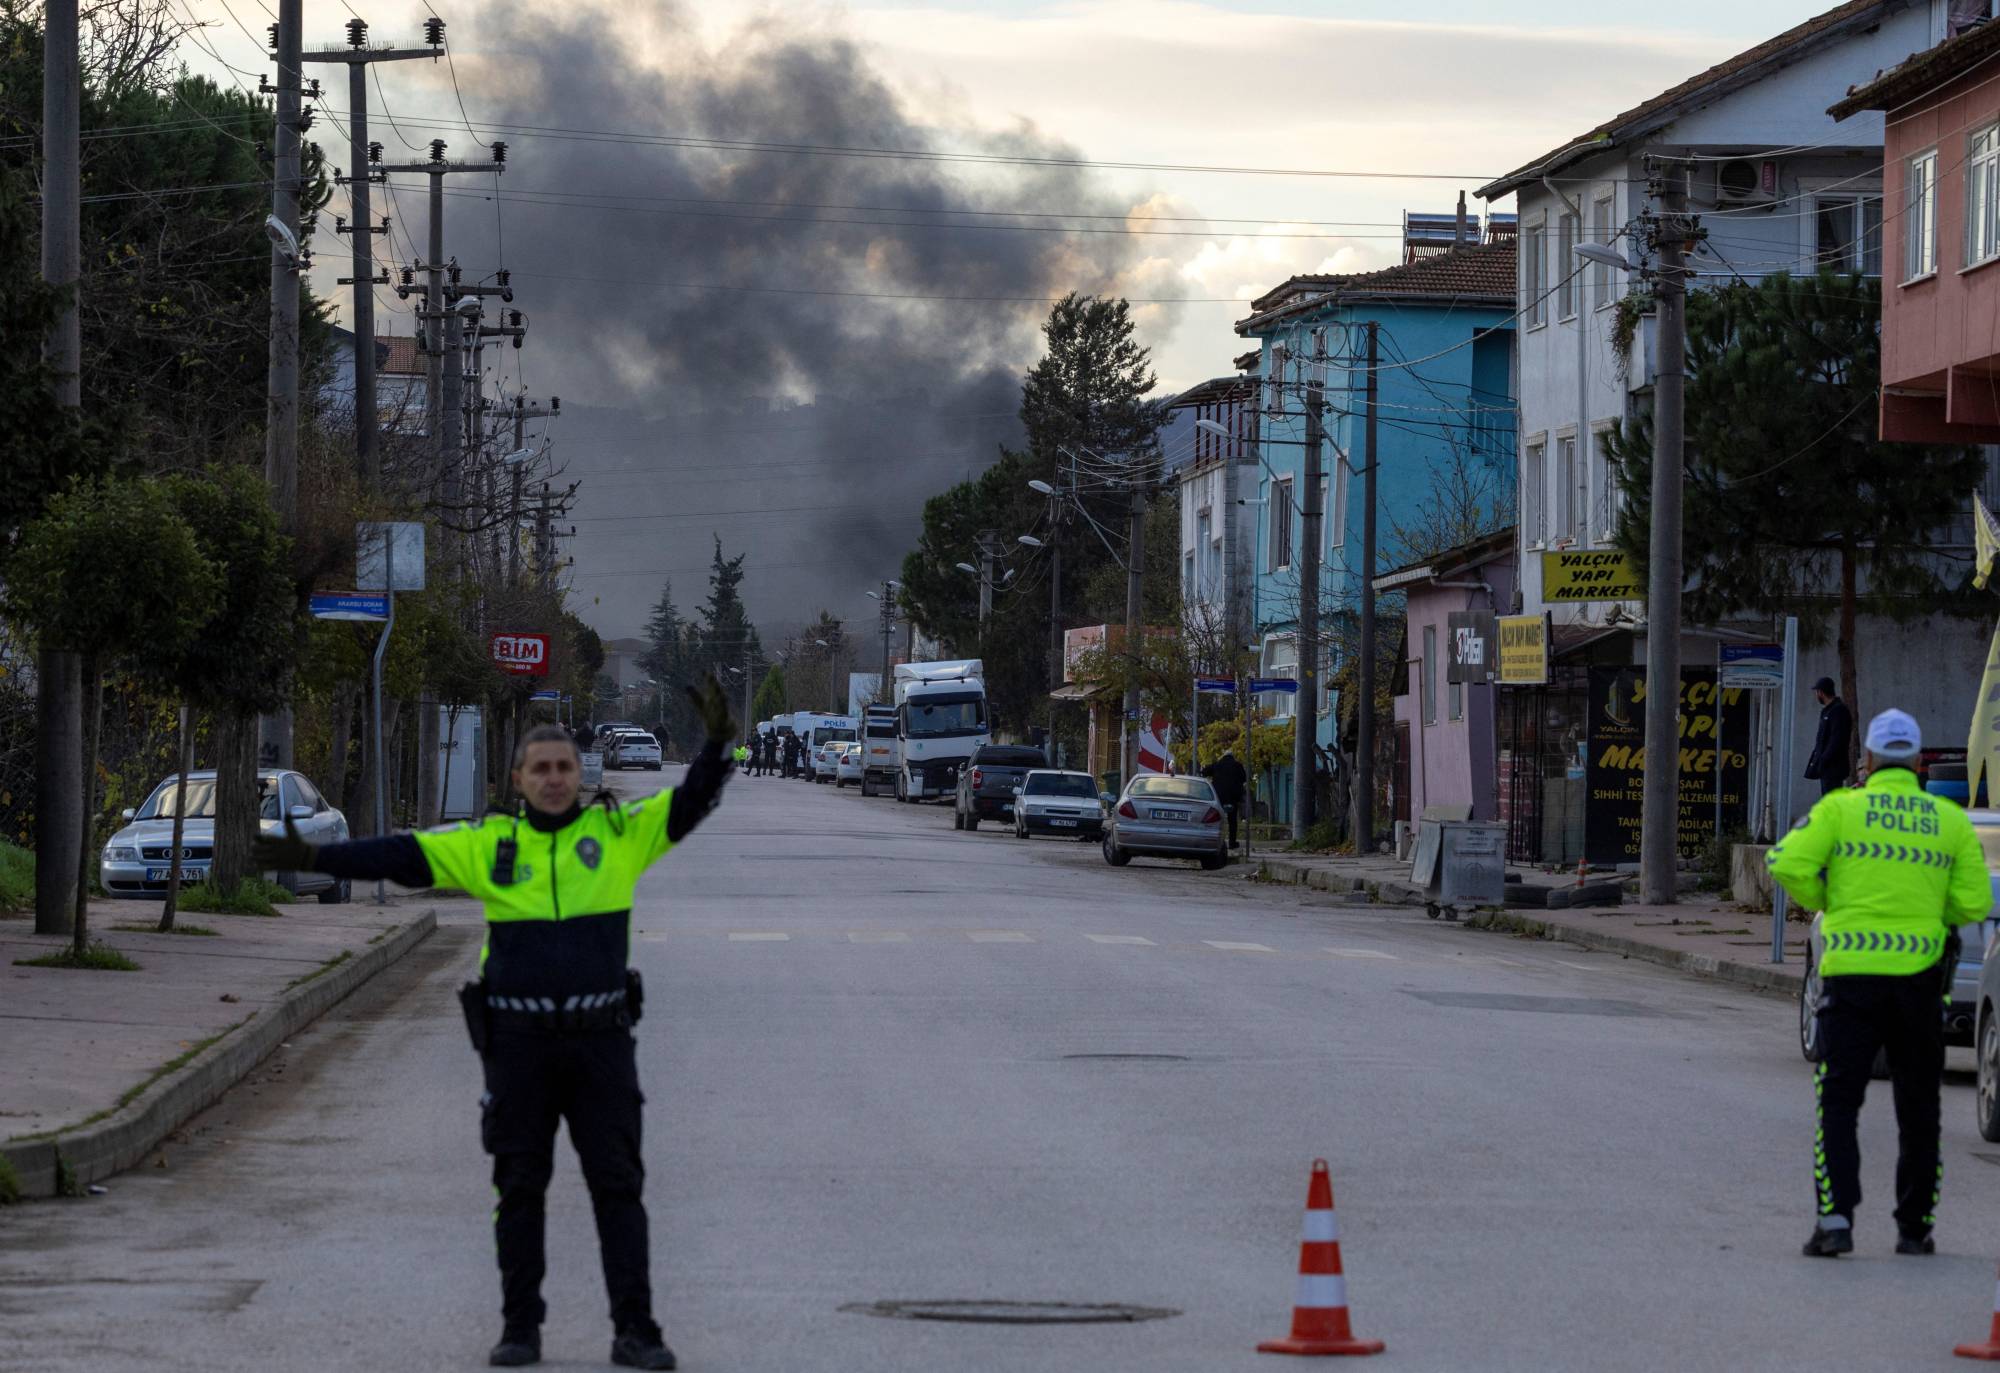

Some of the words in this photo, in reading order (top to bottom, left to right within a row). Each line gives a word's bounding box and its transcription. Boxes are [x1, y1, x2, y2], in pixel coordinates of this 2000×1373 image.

[1560, 554, 1624, 569] YALÇIN
[1571, 570, 1615, 582] YAPI
[1555, 584, 1632, 598] MARKET
[1598, 744, 1734, 773] MAKET
[1679, 780, 1705, 791] ŞAAT
[1866, 794, 1938, 815] TRAFİK
[1866, 811, 1939, 836] POLİSİ
